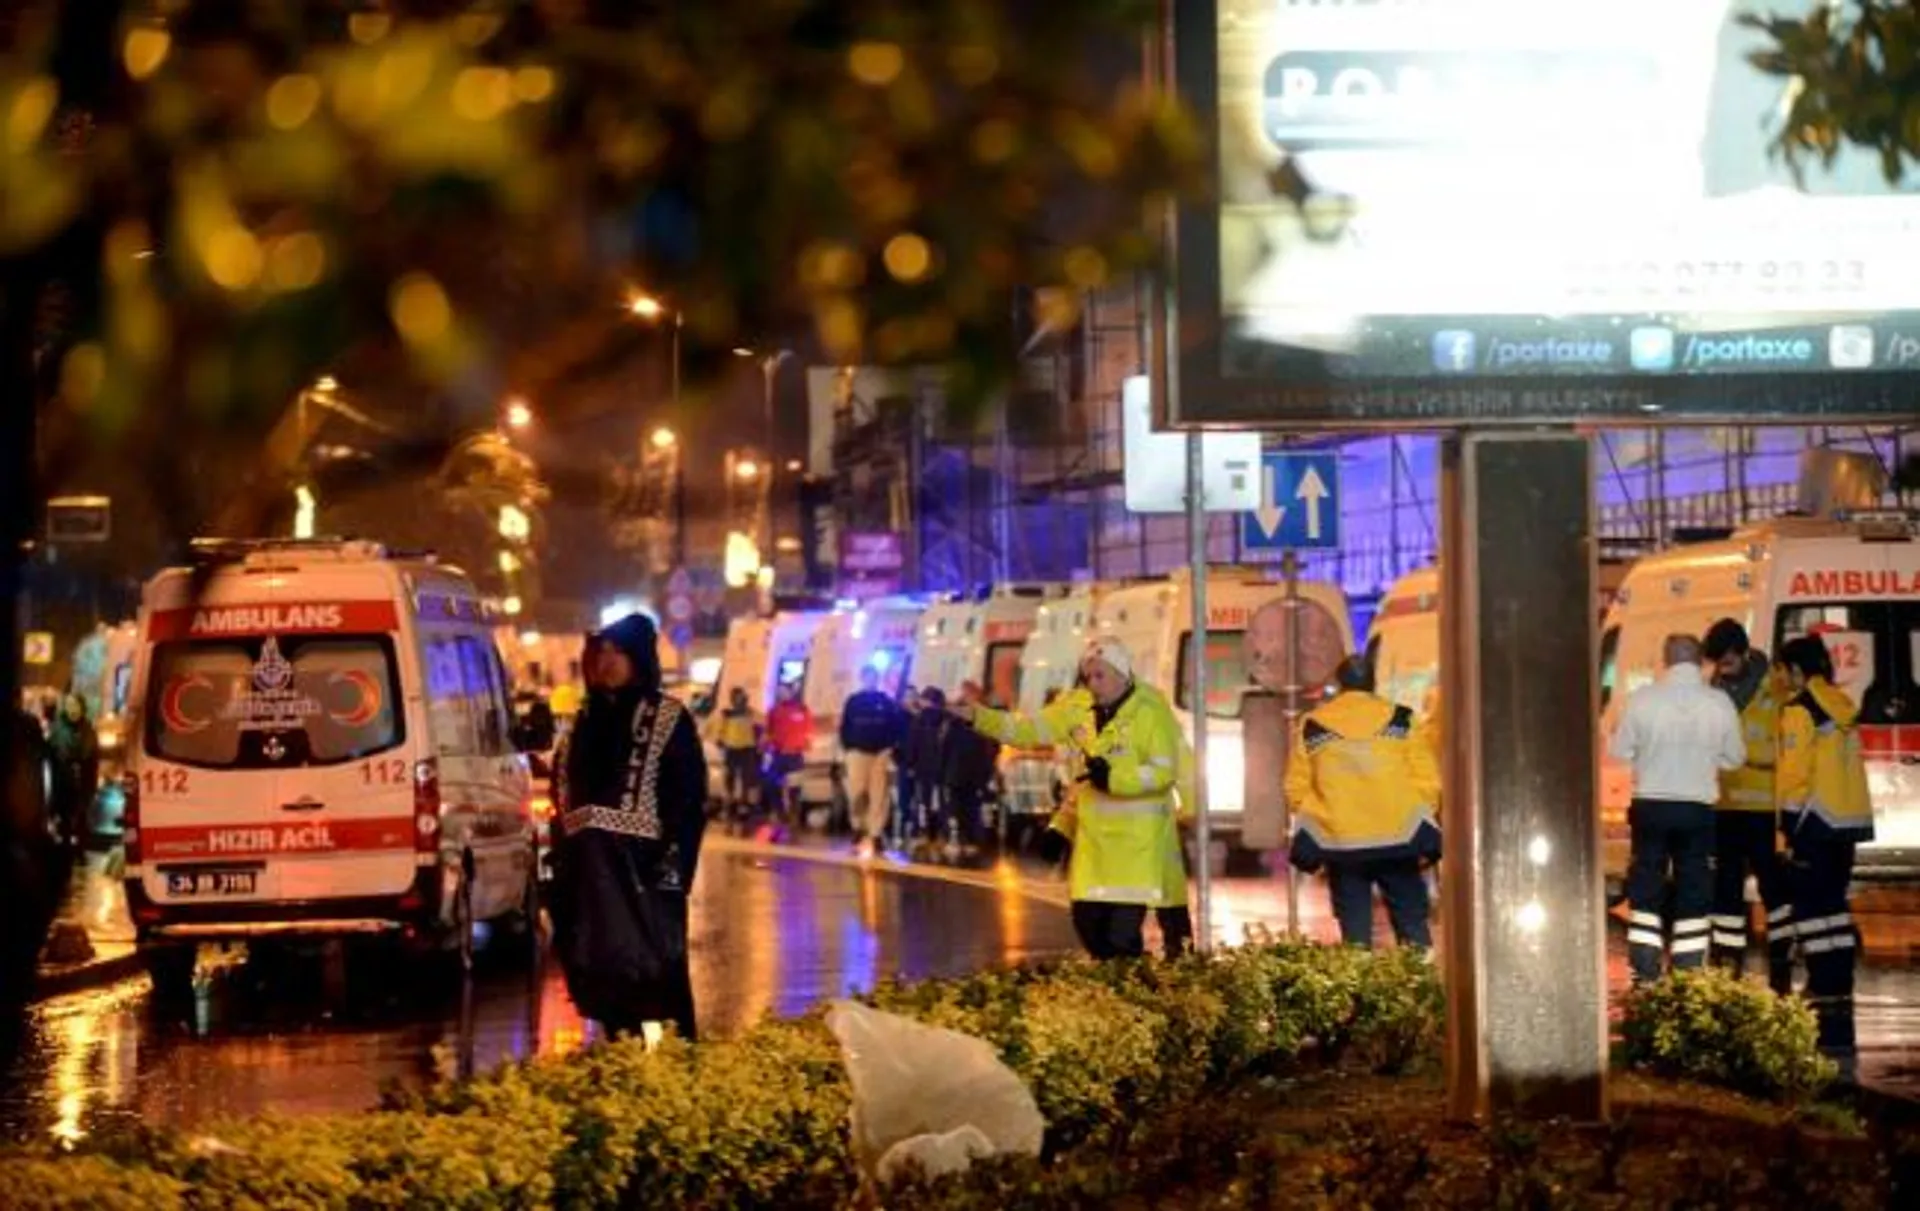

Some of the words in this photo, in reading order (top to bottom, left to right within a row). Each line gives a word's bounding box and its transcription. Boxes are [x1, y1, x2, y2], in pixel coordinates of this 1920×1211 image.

[1683, 334, 1812, 366] /portaxe
[190, 604, 344, 632] AMBULANS
[1831, 643, 1862, 669] 12
[143, 769, 189, 794] 112
[360, 759, 406, 785] 112
[208, 829, 274, 851] HIZIR
